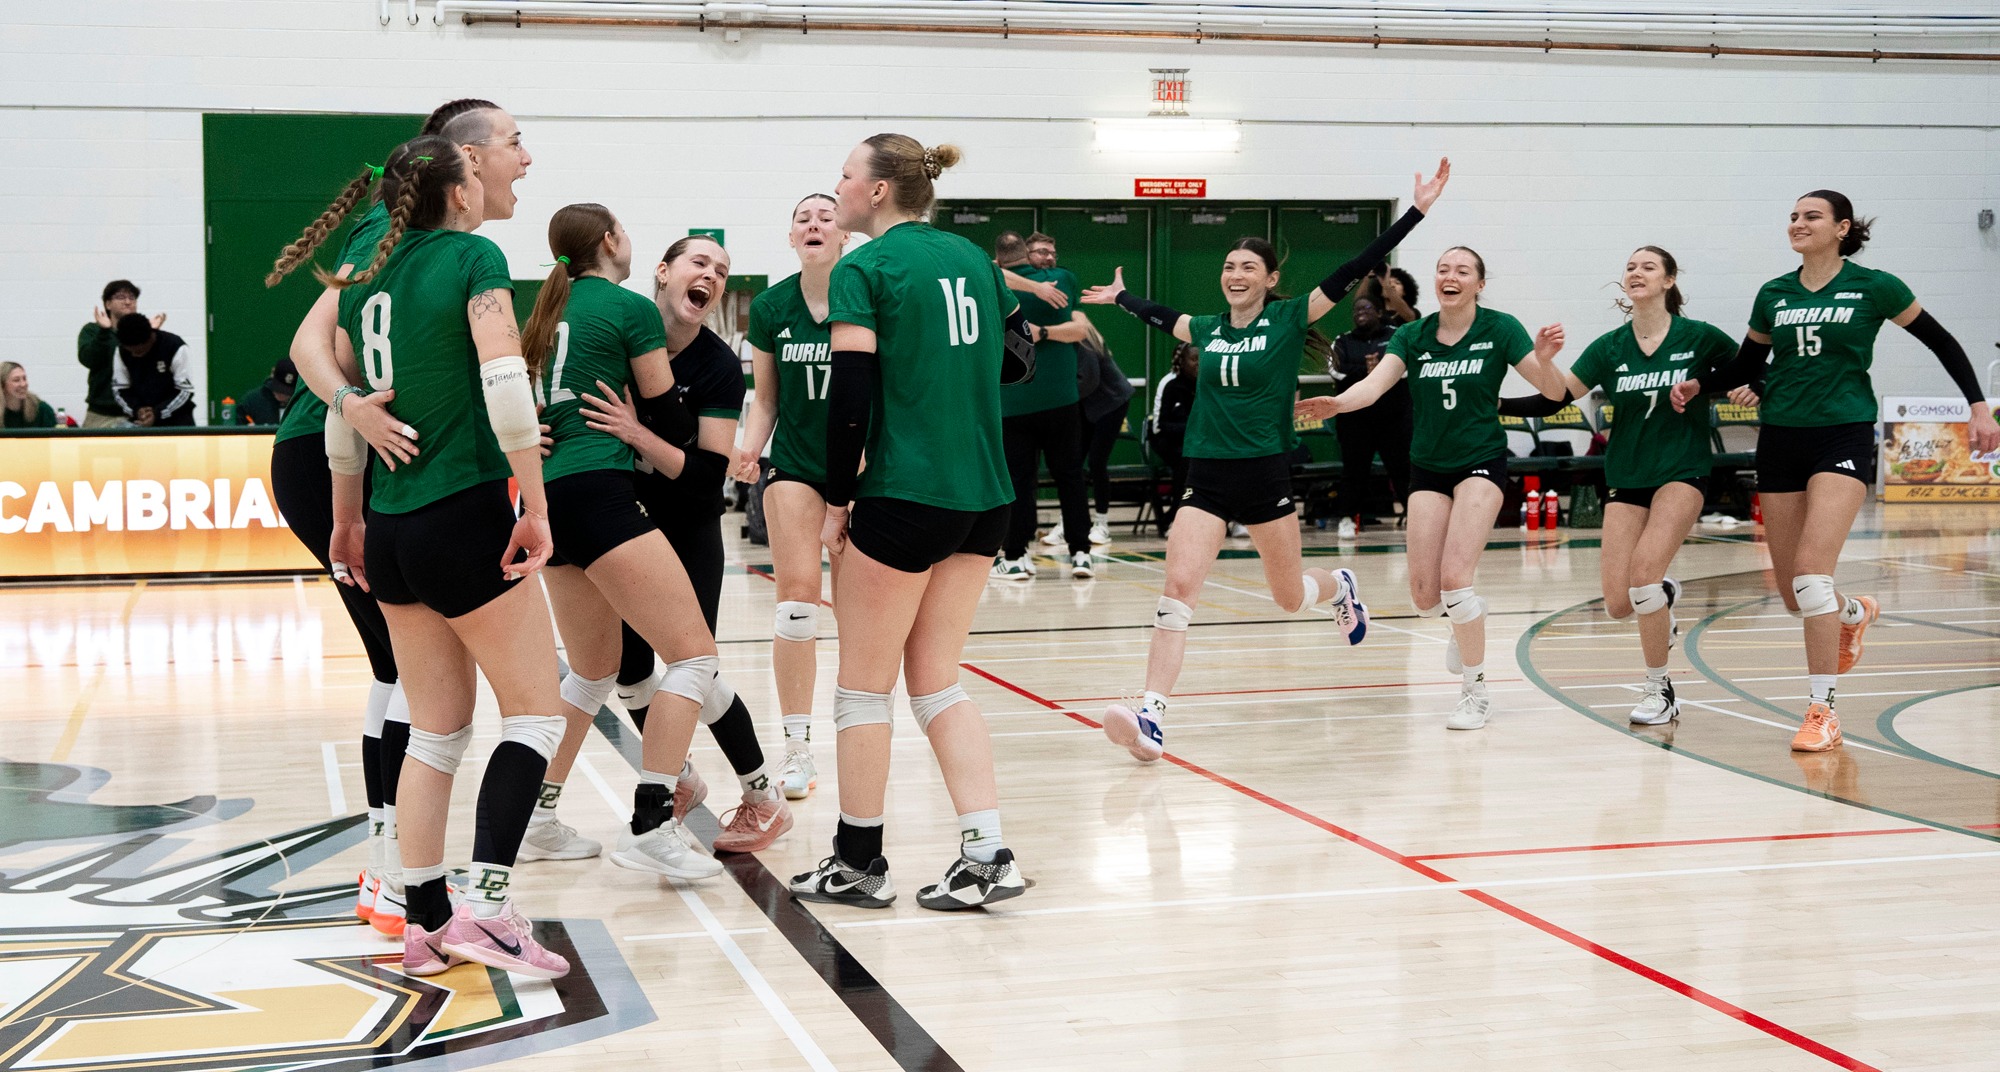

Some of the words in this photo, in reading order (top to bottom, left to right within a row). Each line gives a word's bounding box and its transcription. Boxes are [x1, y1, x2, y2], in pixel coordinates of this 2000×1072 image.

[937, 277, 979, 346] 16
[1774, 307, 1855, 327] DURHAM
[361, 291, 393, 391] 8
[781, 343, 832, 362] DURH
[1795, 325, 1822, 357] 15
[805, 364, 832, 400] 17
[1220, 355, 1239, 387] 11
[1419, 358, 1484, 378] DURHAM
[1615, 368, 1689, 393] DURHAM
[1442, 378, 1457, 410] 5
[1642, 390, 1659, 420] 7
[1908, 405, 1963, 415] GOMOKU
[1914, 440, 1953, 450] DAILY
[0, 478, 290, 533] CAMBRIA
